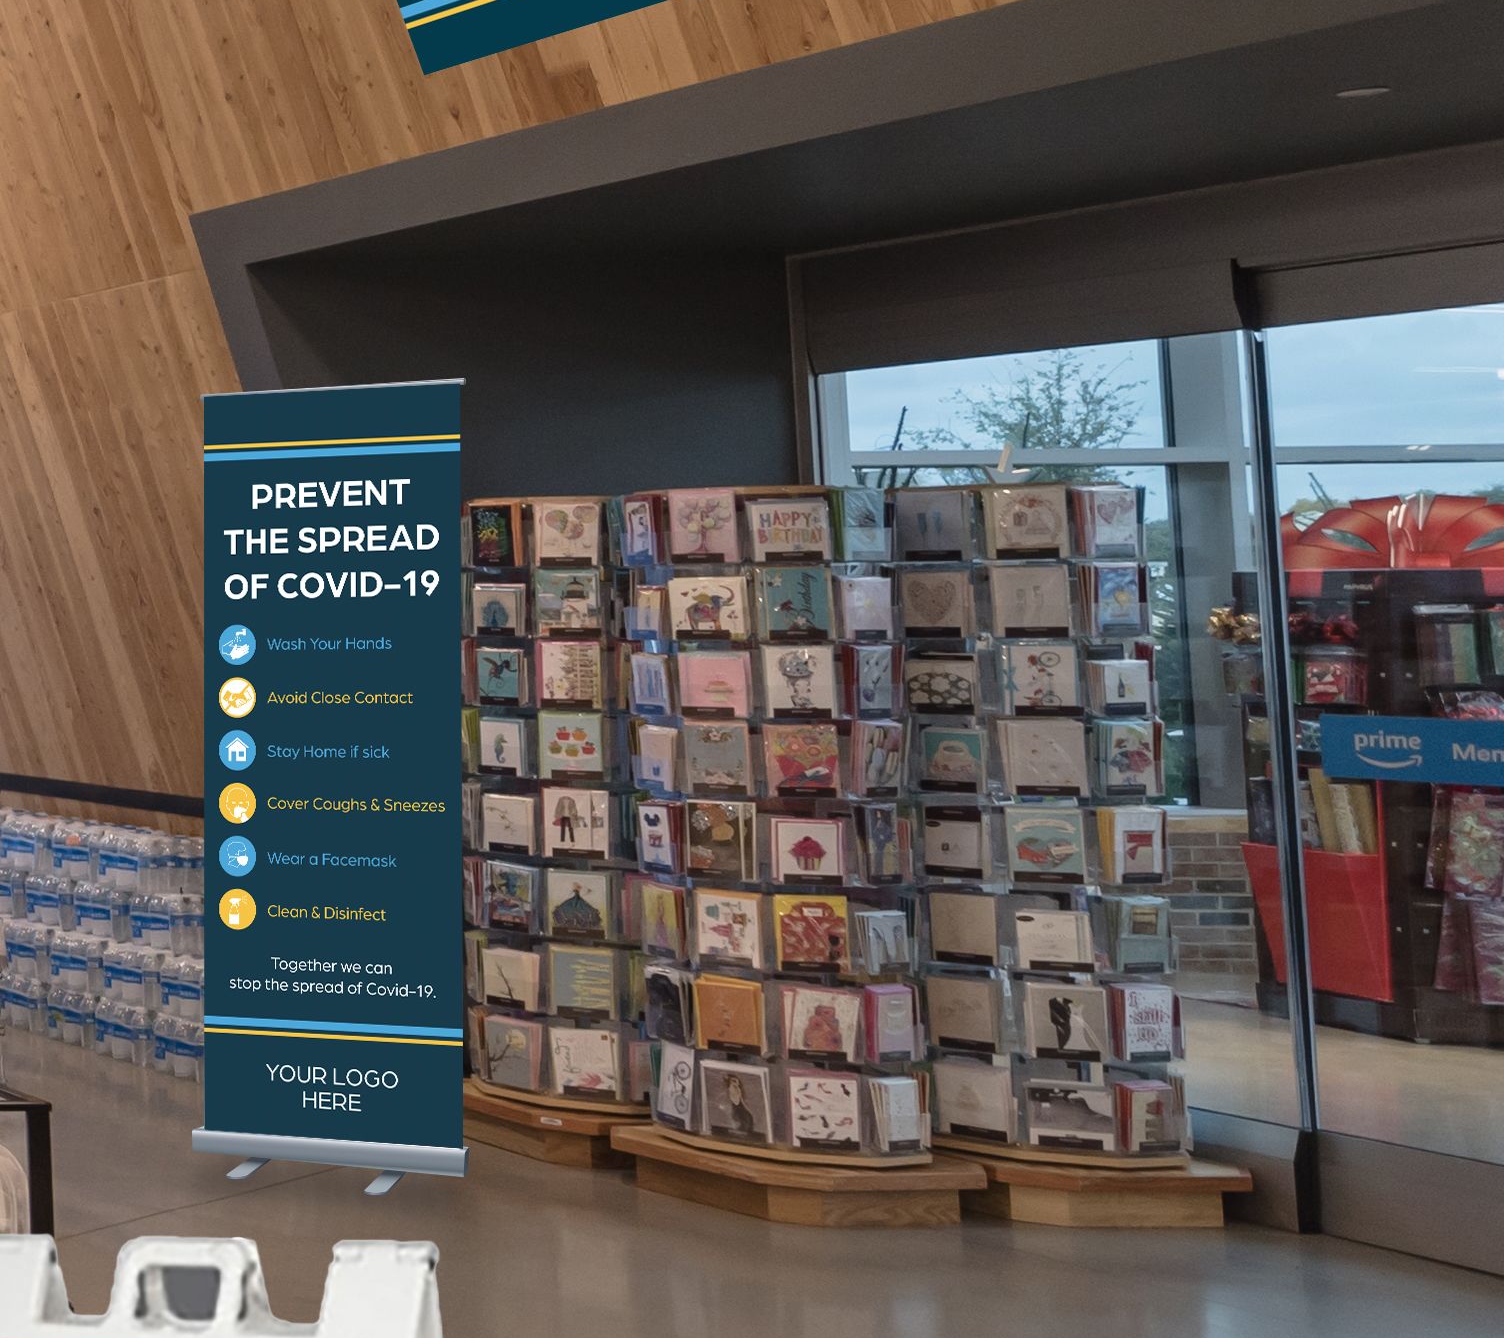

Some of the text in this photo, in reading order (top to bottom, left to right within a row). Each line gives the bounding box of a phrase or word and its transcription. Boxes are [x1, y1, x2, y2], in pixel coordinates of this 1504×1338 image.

[252, 479, 410, 509] PREVENT
[224, 524, 439, 555] THE SPREAD
[225, 570, 439, 599] OF COVID-19
[266, 636, 393, 651] Wash Your Hands
[267, 691, 414, 705] Avoid Close Contact
[1354, 730, 1422, 751] prime
[266, 744, 390, 760] Stay Home if sick
[267, 796, 446, 814] Cover Coughs & Sneezes
[266, 851, 397, 868] Wear a Facemask
[267, 904, 387, 922] Clean & Disinfect
[270, 956, 393, 975] Together we can
[229, 977, 437, 999] stop the spread of Covid-19.
[266, 1064, 398, 1088] YOUR LOGO
[303, 1091, 361, 1111] HERE
